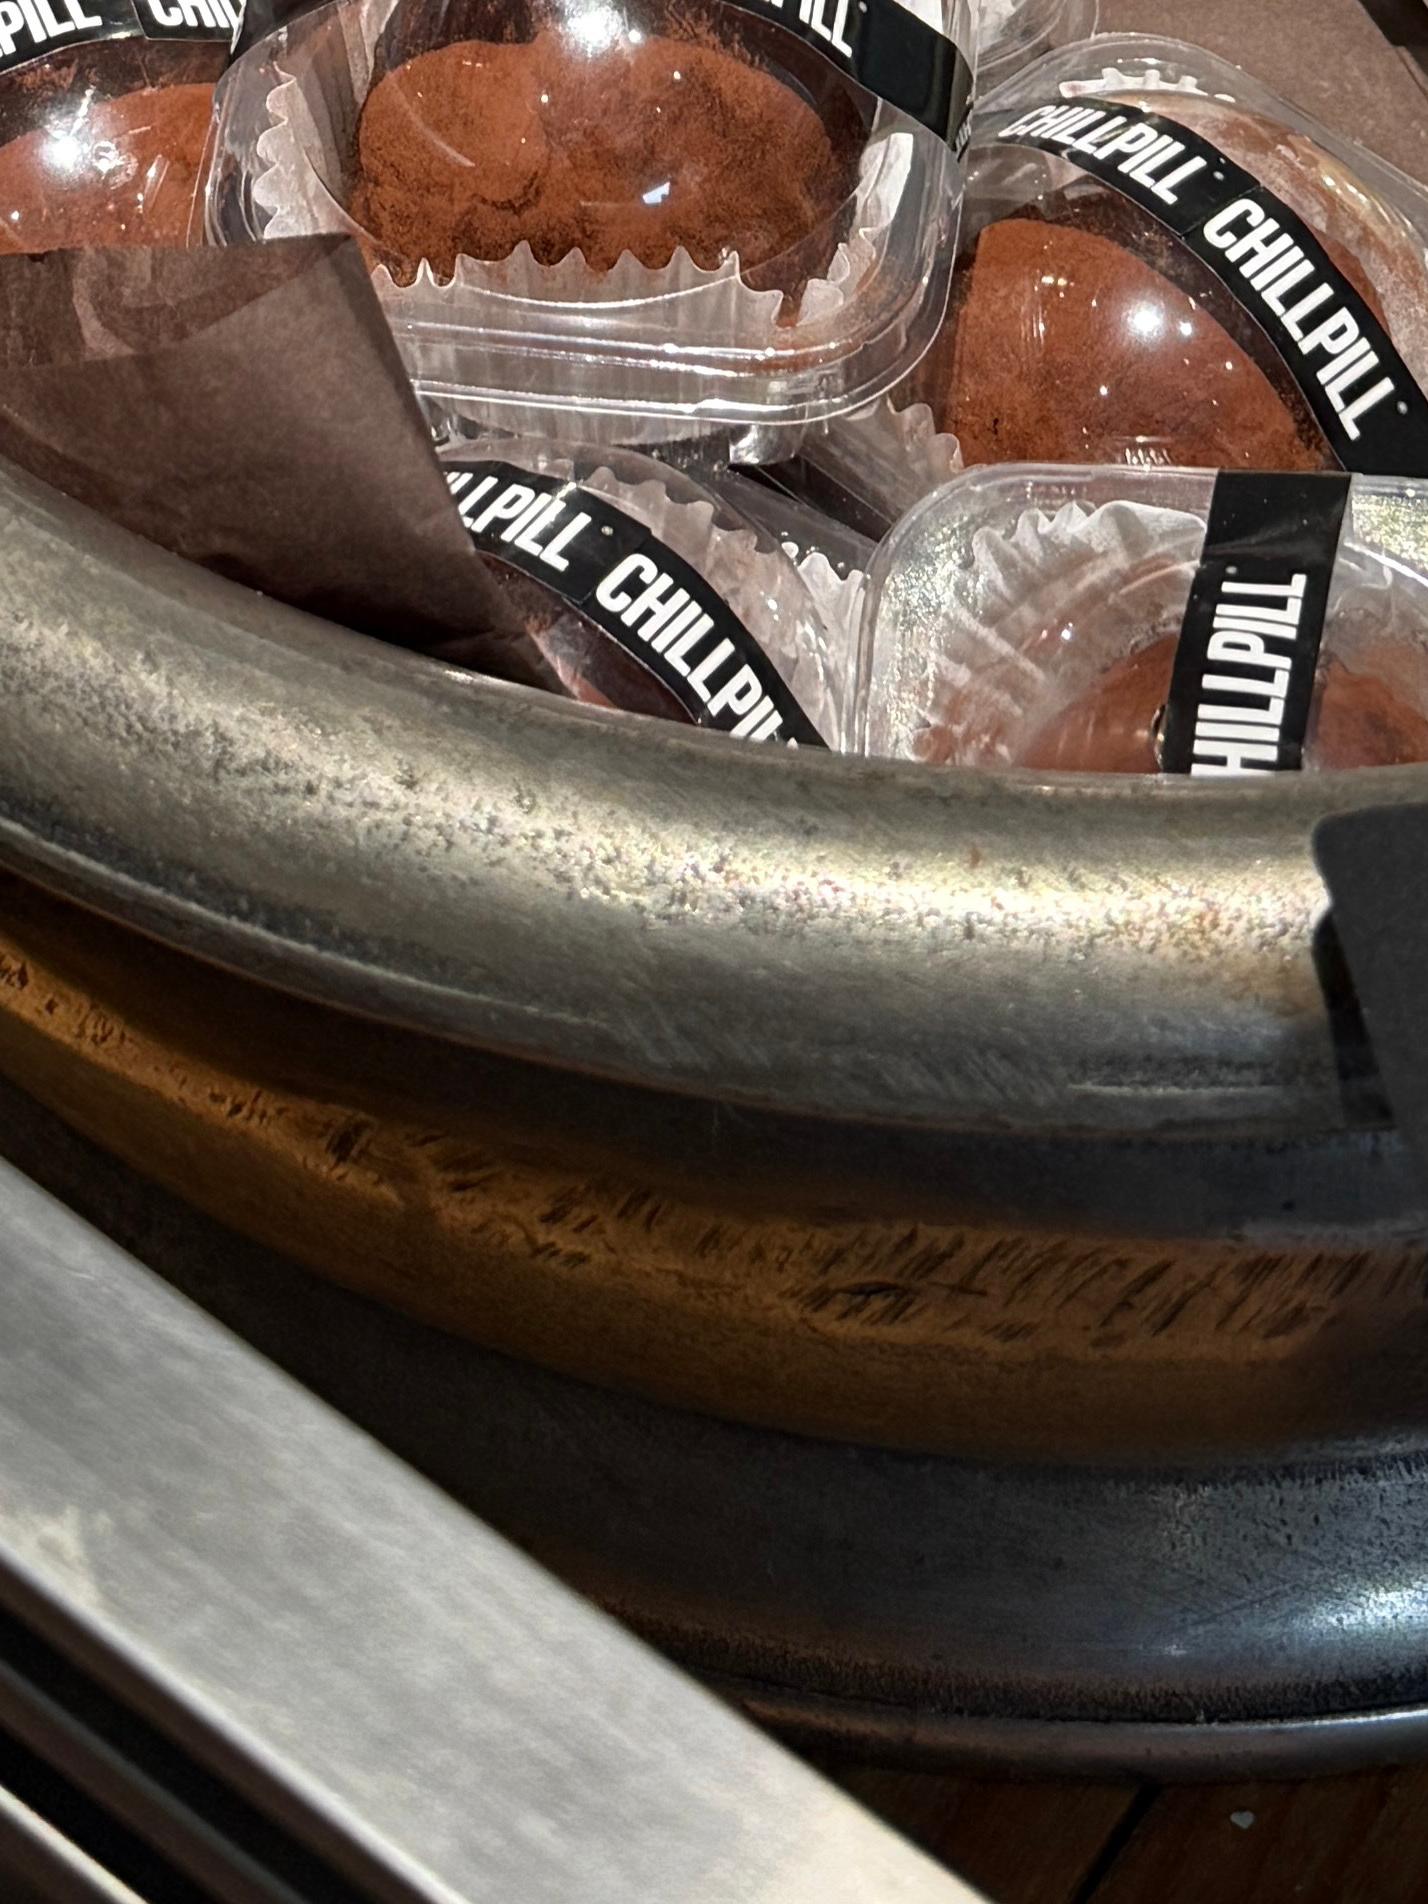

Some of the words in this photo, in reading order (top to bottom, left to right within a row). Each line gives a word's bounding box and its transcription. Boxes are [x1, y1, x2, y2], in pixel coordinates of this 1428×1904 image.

[997, 104, 1206, 205] CHILLPILL
[1203, 198, 1395, 442] CHILLPILL
[444, 471, 592, 573] LPILL
[1190, 573, 1307, 776] HILLPILL
